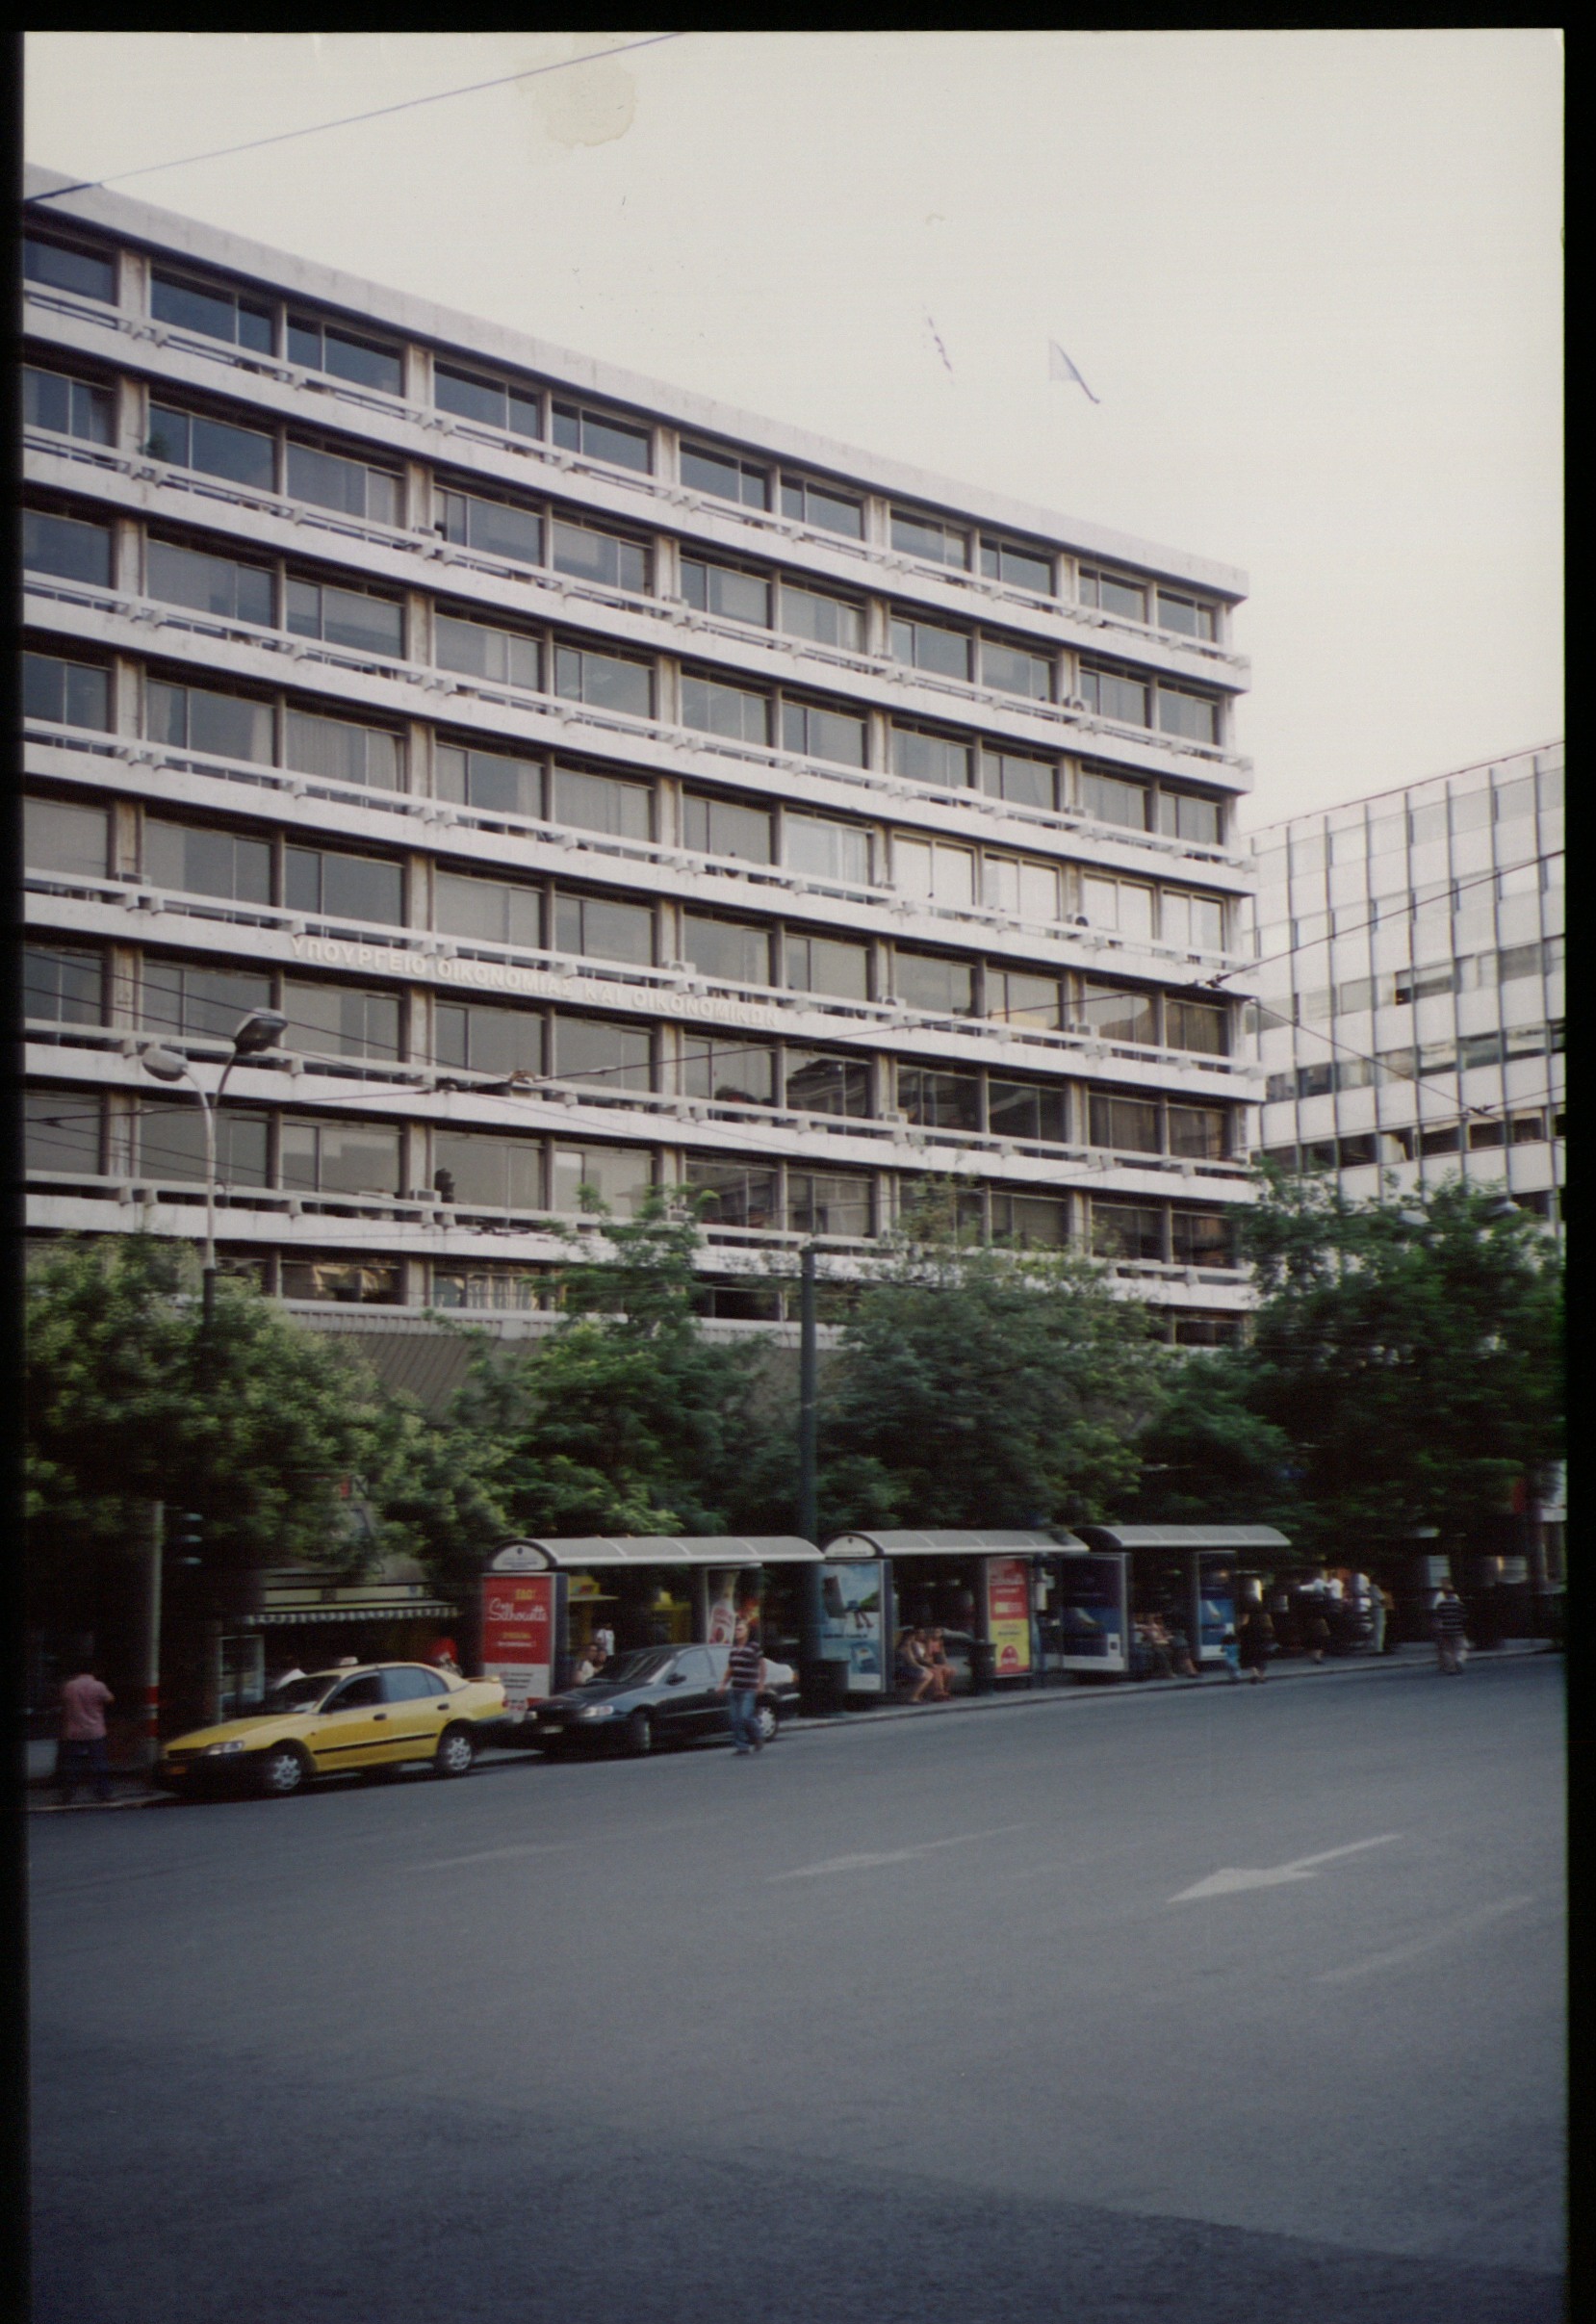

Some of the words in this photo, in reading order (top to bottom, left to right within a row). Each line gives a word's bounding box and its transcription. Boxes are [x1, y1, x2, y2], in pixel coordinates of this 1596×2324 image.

[292, 937, 426, 975] ΥΠΟΥΡΓΕΙΟ
[438, 959, 573, 998] ΟΙΚΟΝΟΜΙΑΣ
[584, 981, 621, 1005] ΚΑΙ
